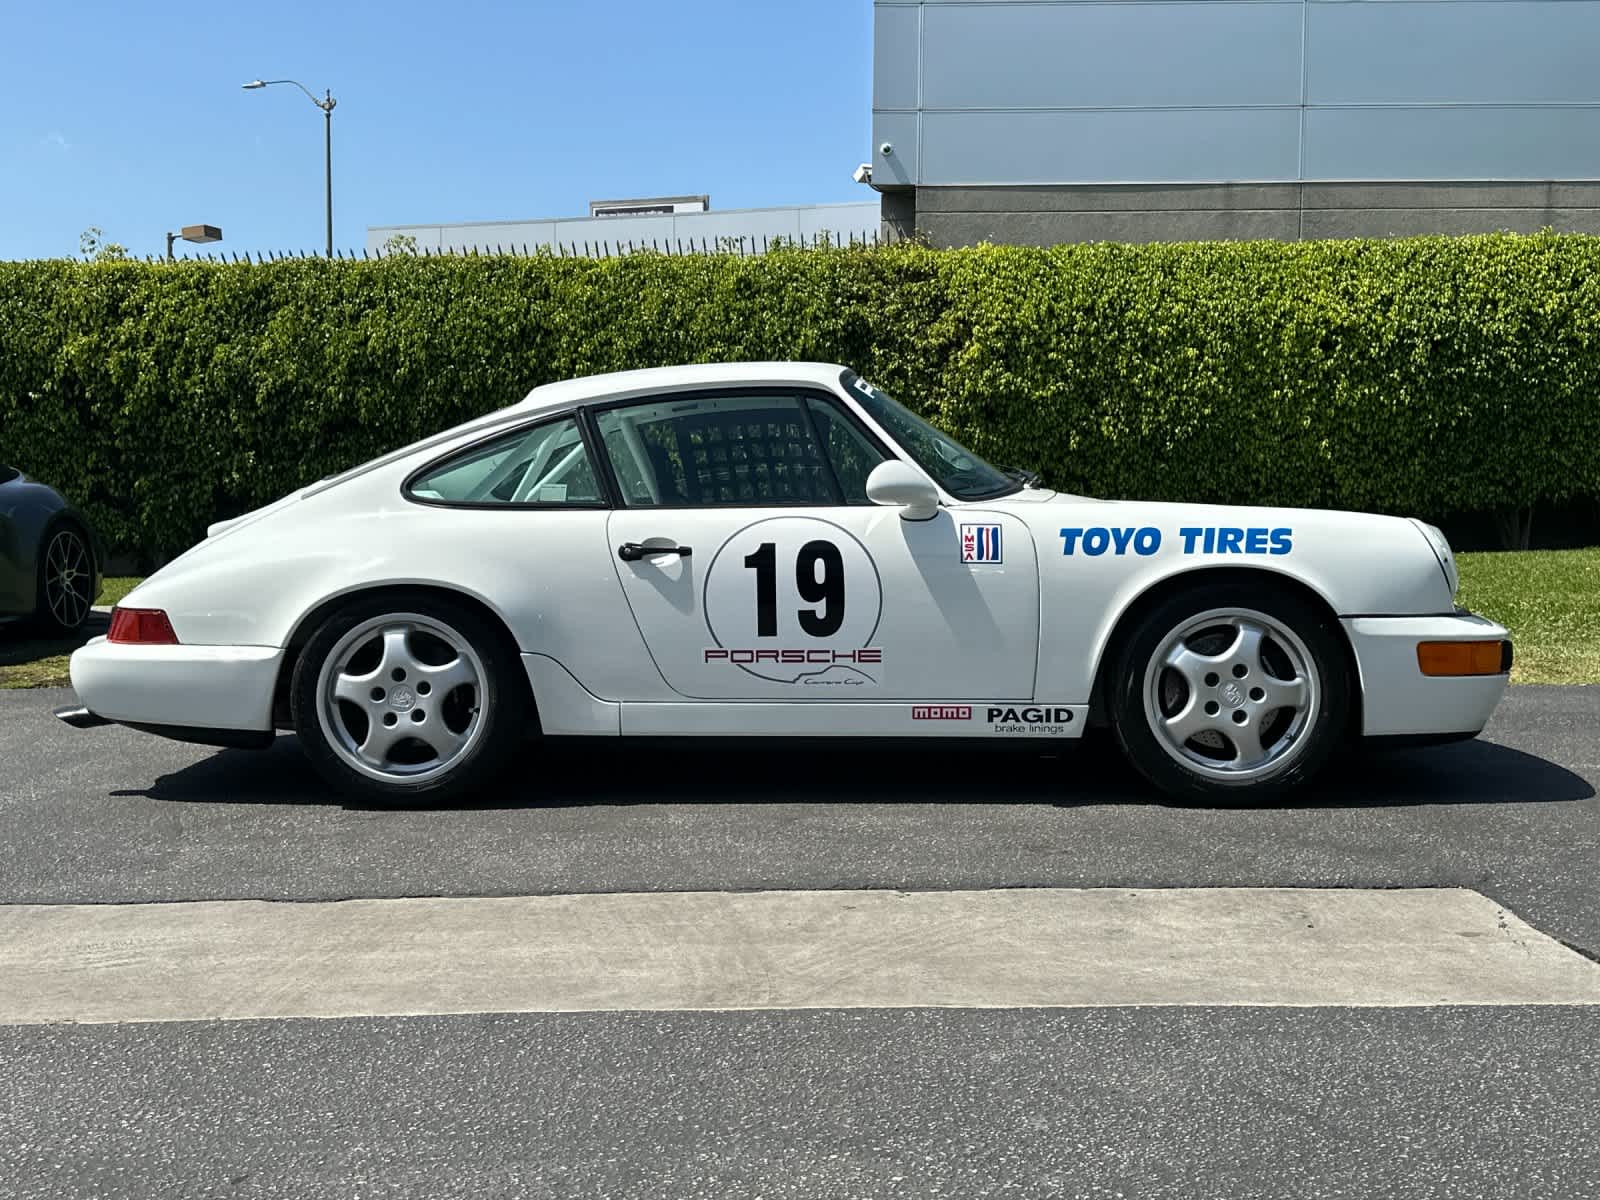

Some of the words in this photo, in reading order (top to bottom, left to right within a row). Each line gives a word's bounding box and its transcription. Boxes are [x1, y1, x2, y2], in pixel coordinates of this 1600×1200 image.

[964, 527, 975, 561] IMSA
[1059, 527, 1162, 556] TOYO
[1179, 527, 1293, 555] TIRES
[744, 539, 845, 637] 19
[704, 649, 882, 664] PORSCHE
[844, 678, 865, 686] Cup
[987, 708, 1074, 723] PAGID
[995, 724, 1025, 733] brake
[1029, 724, 1064, 735] linings
